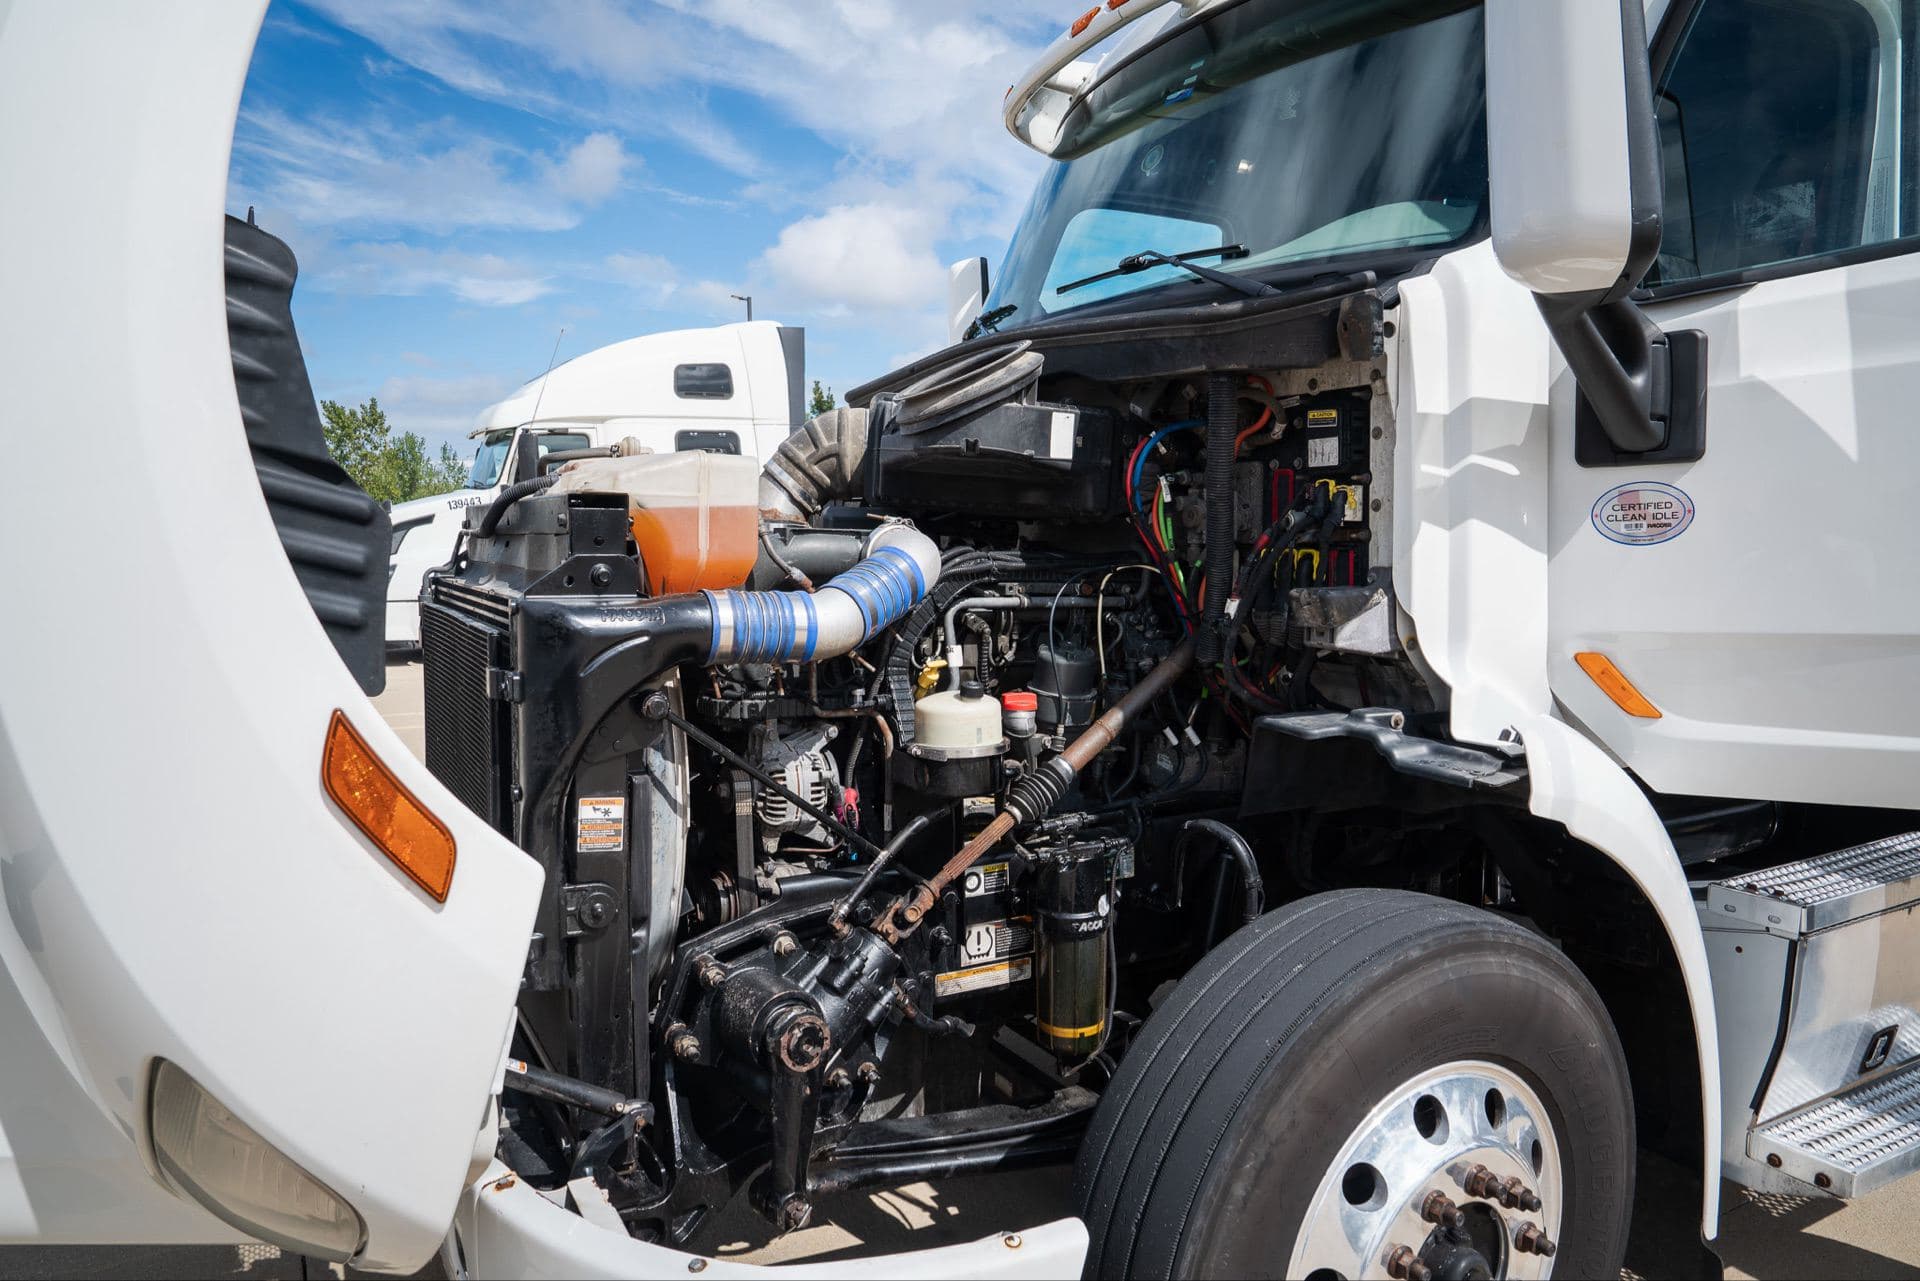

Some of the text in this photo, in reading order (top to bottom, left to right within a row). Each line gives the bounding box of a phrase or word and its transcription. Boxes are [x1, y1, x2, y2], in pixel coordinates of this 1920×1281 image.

[447, 496, 482, 511] 139443
[1611, 501, 1673, 512] CERTIFIED
[1606, 512, 1680, 522] CLEAN IDLE
